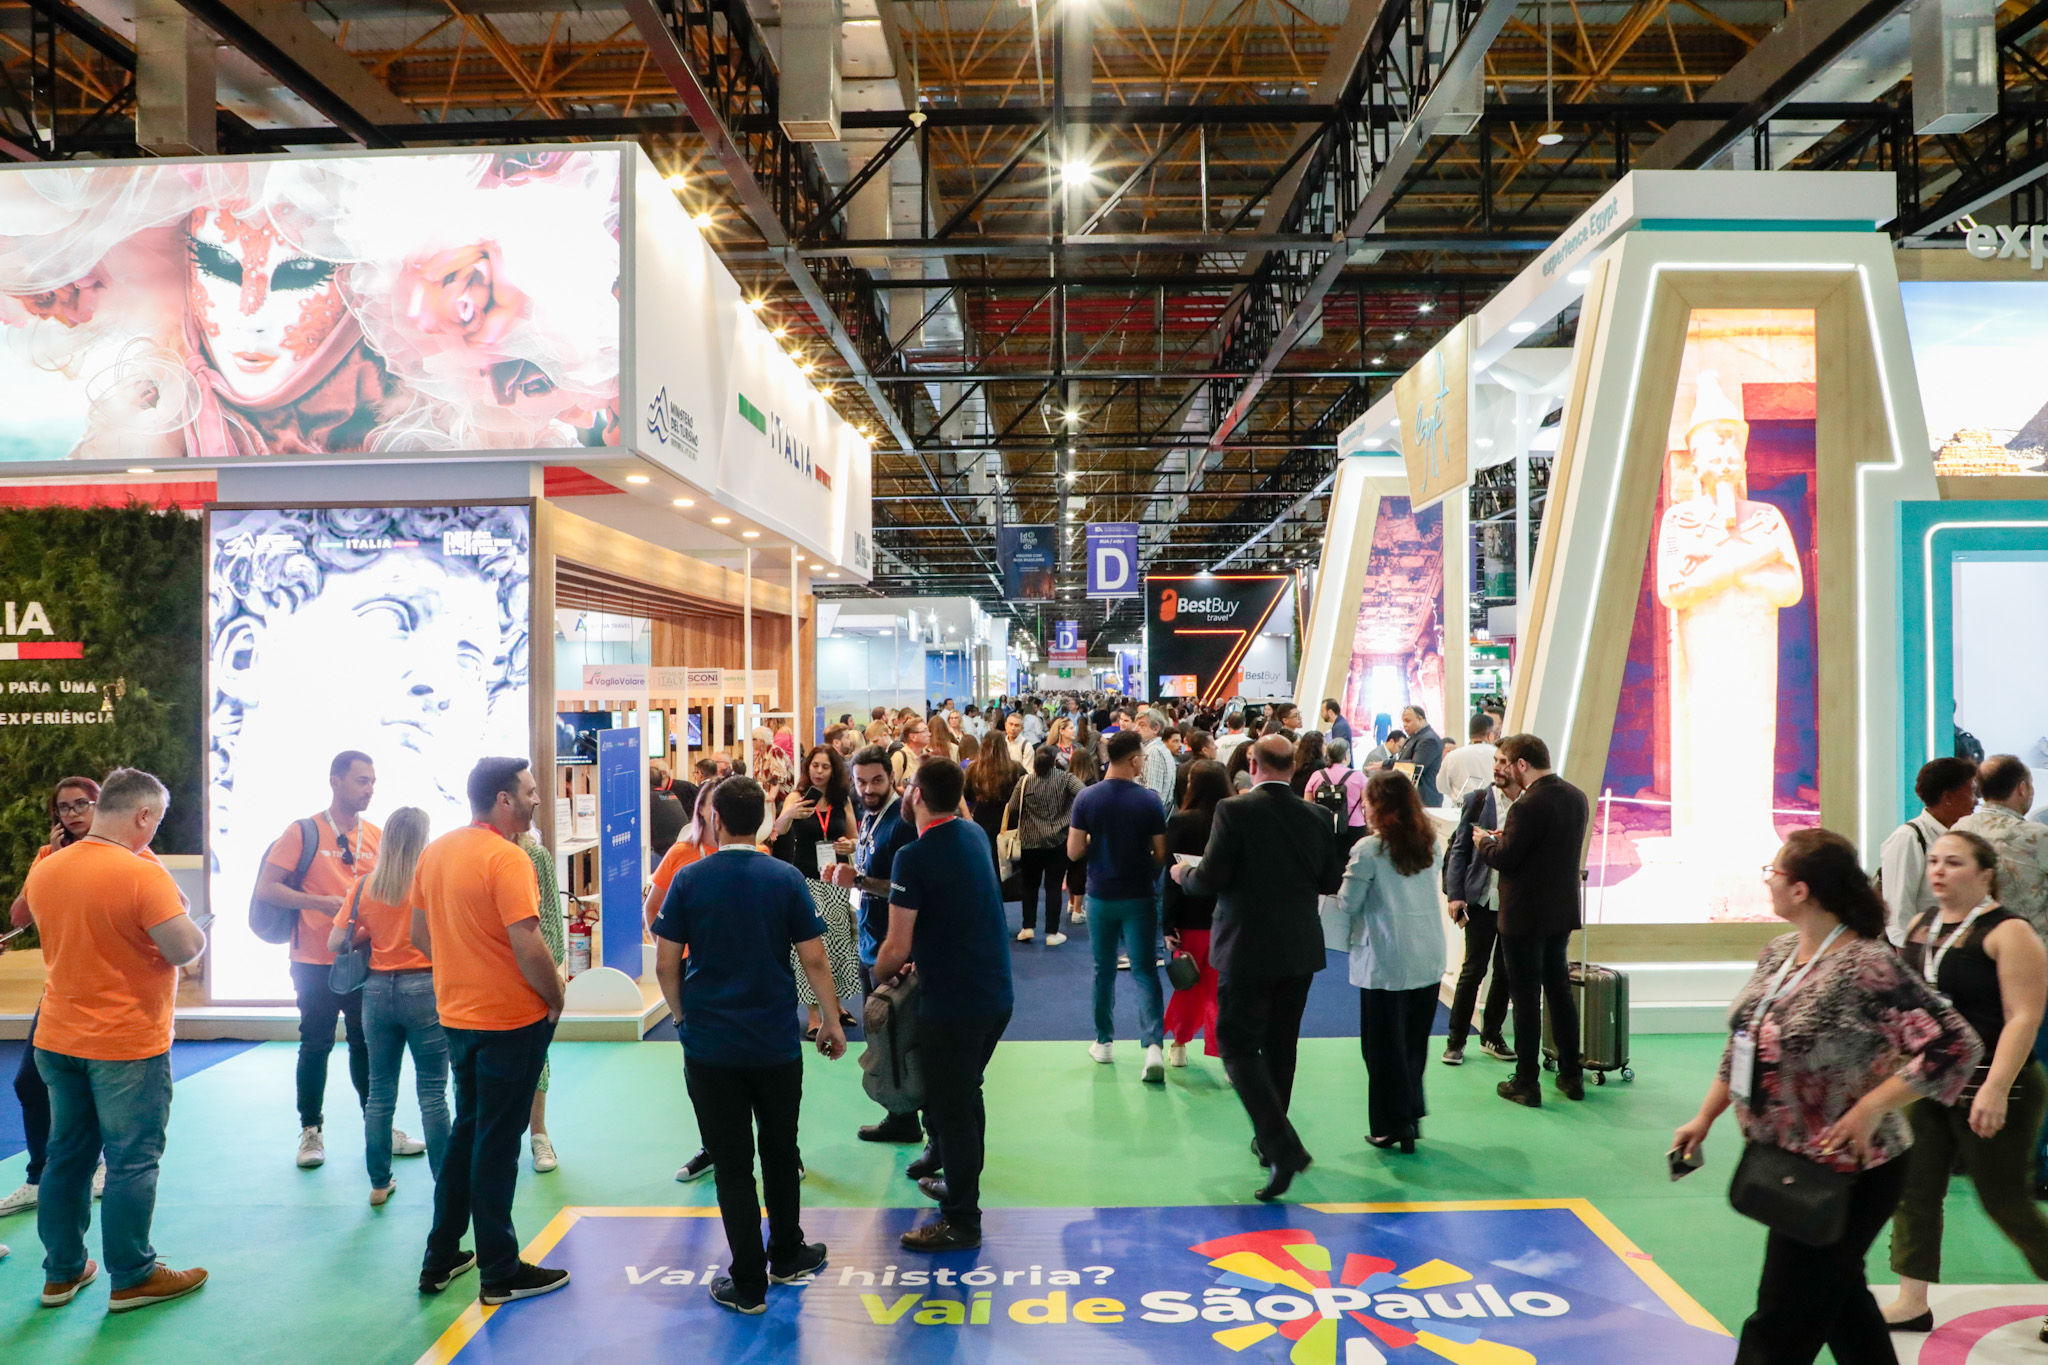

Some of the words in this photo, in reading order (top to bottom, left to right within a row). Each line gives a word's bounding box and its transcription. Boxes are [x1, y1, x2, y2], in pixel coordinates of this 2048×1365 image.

[1542, 226, 1589, 277] experience
[1590, 196, 1618, 236] Egypt
[770, 410, 812, 480] ITALIA
[345, 539, 393, 550] ITALIA
[1096, 547, 1130, 590] D
[1177, 598, 1240, 617] BestBuy
[0, 601, 55, 636] IA
[1206, 614, 1229, 622] travel
[1059, 630, 1074, 649] D
[1245, 671, 1280, 681] BestBuy
[9, 681, 51, 694] PARA
[60, 681, 98, 694] UMA
[624, 1265, 721, 1286] Vai
[837, 1265, 1116, 1287] história?
[859, 1291, 993, 1325] Vai
[1007, 1291, 1126, 1324] de
[1140, 1284, 1571, 1322] SãoPaulo
